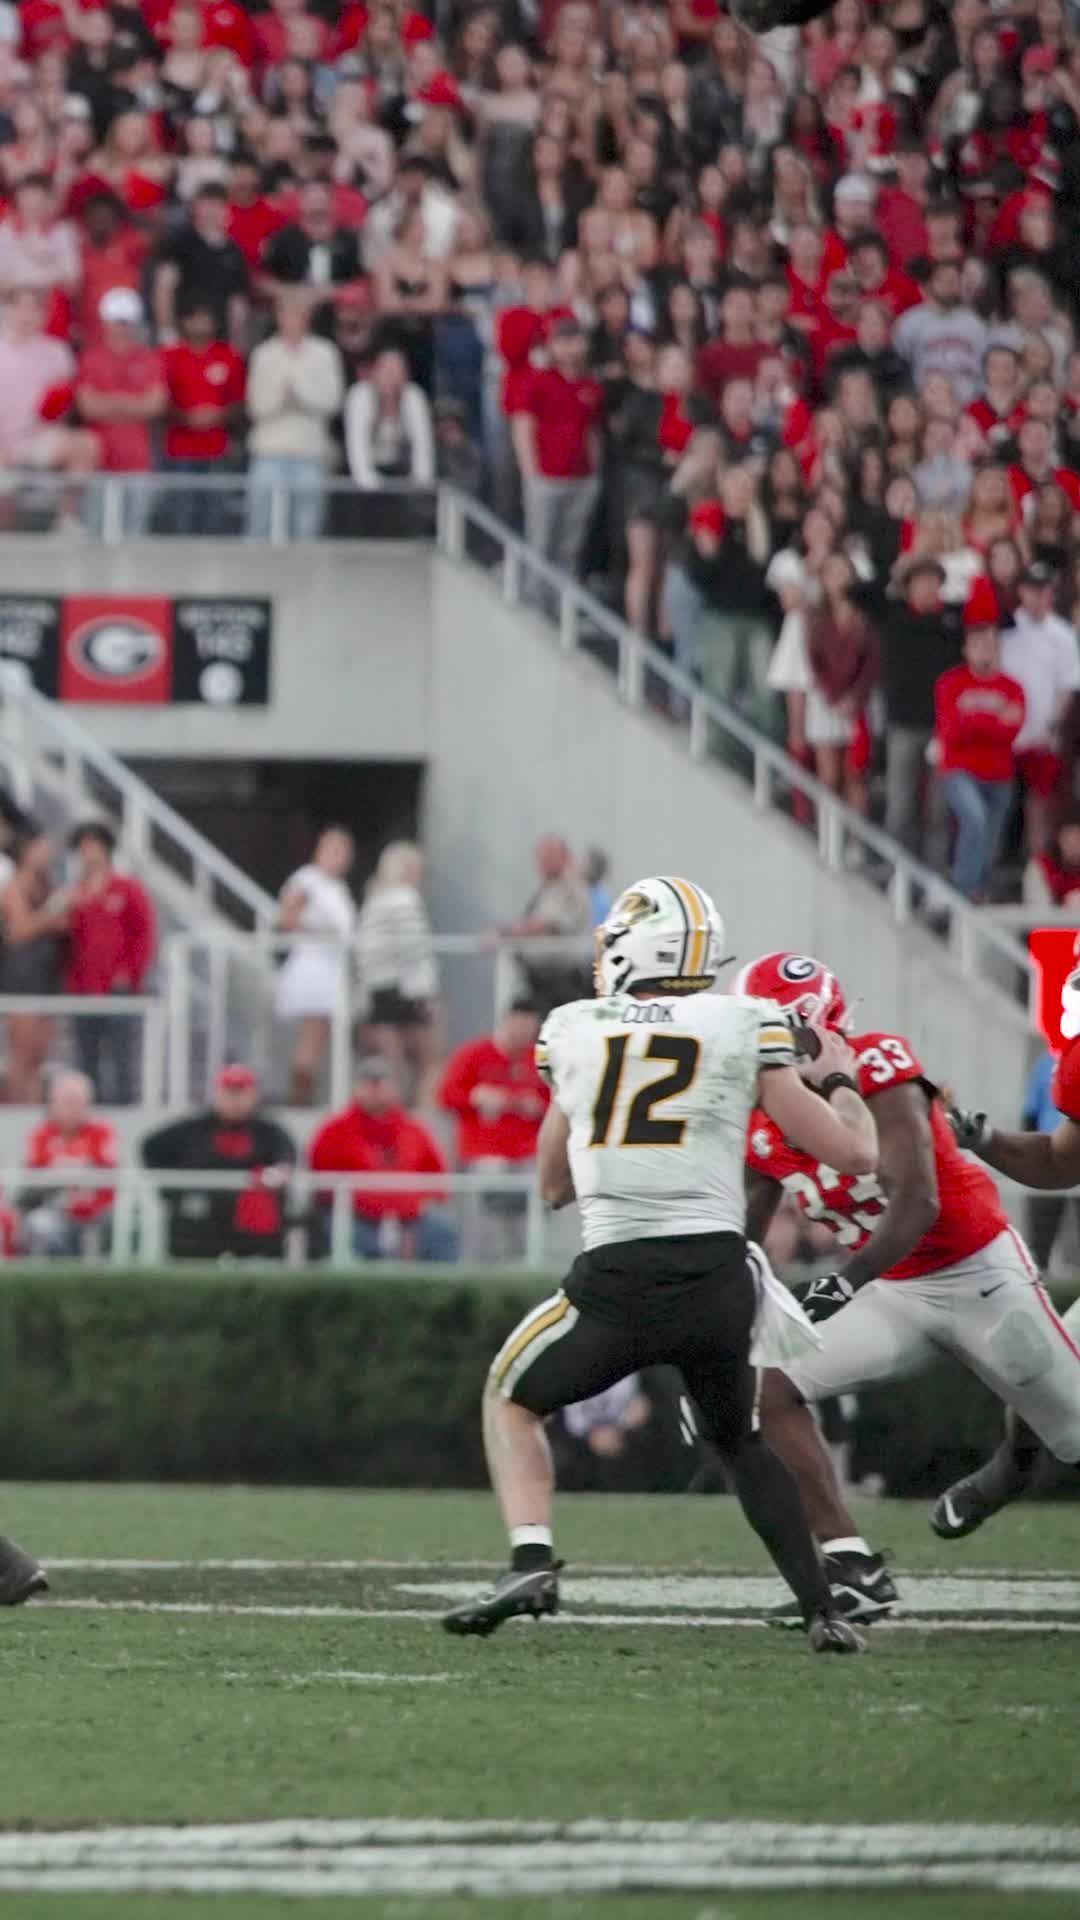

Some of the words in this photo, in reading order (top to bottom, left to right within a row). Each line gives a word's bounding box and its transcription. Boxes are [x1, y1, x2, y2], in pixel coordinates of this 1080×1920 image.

[782, 955, 817, 981] G
[622, 1003, 675, 1024] COOK
[857, 1039, 913, 1083] 33
[587, 1032, 702, 1150] 12
